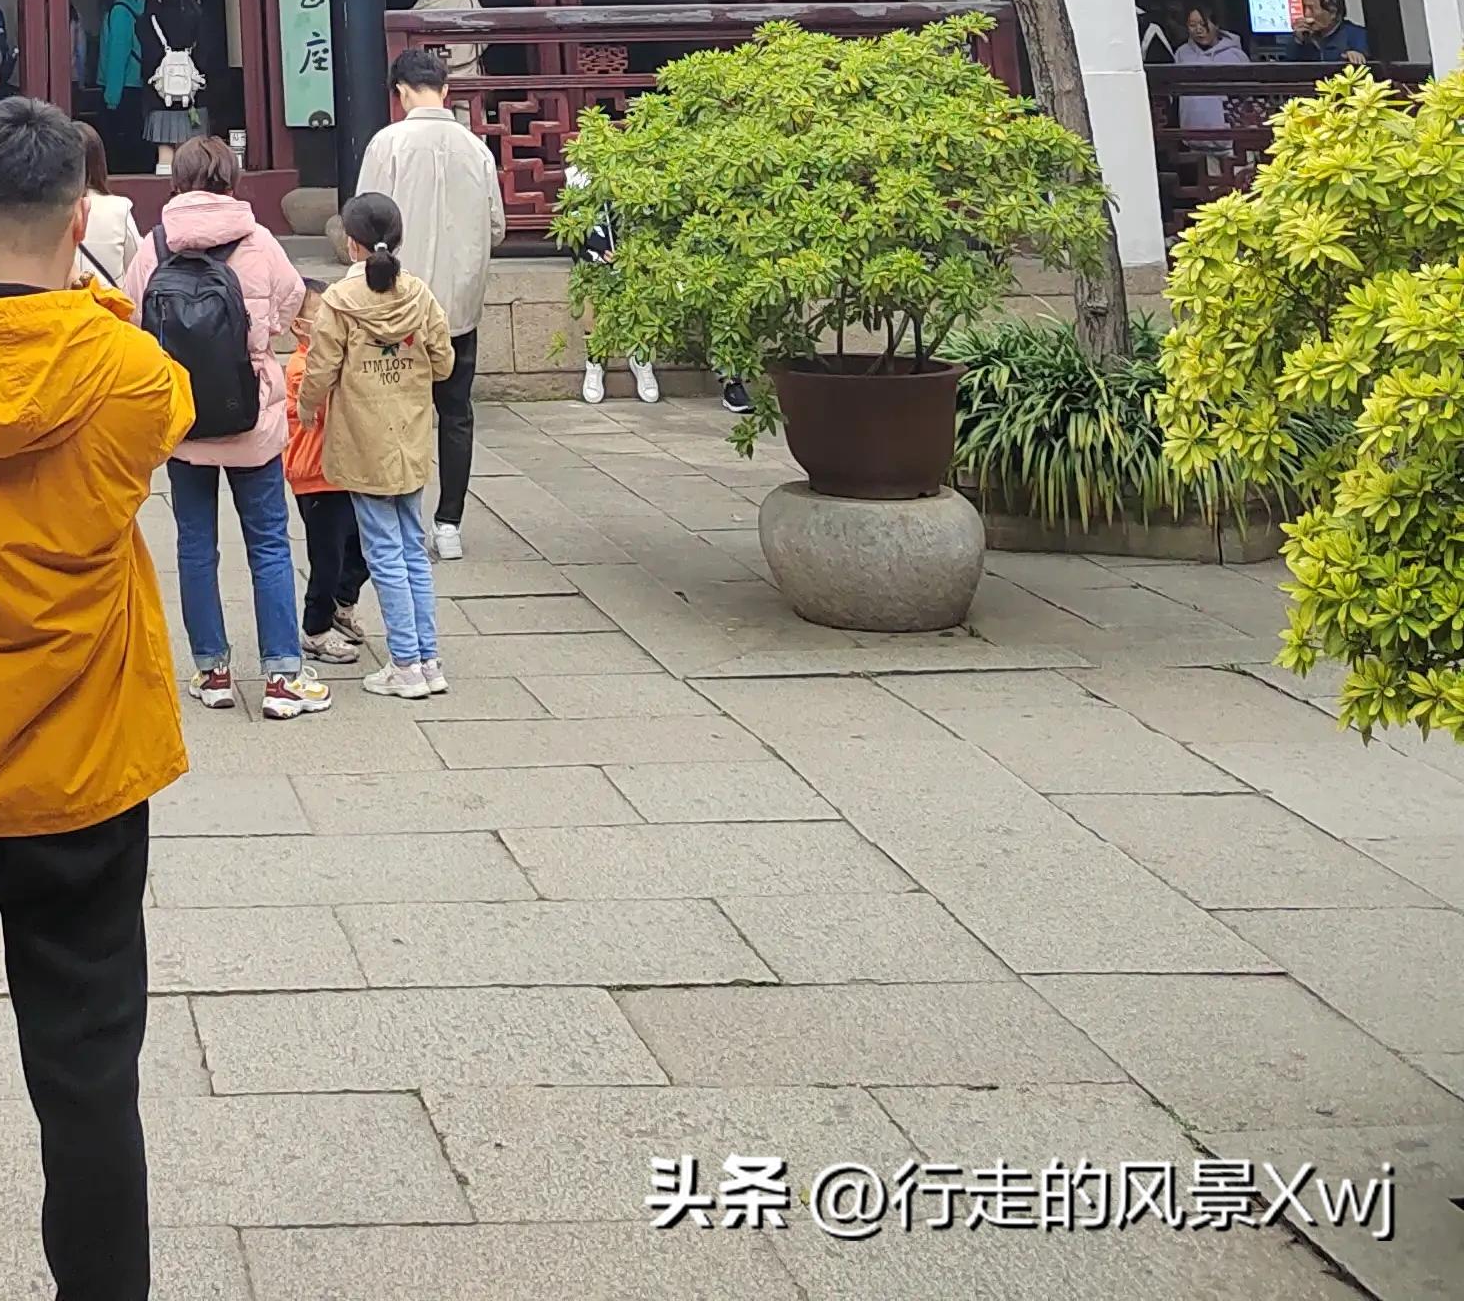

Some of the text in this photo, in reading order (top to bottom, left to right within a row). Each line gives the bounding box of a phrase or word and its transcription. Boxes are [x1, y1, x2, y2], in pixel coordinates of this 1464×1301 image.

[362, 357, 414, 373] I'M LOST
[379, 371, 401, 385] TOO
